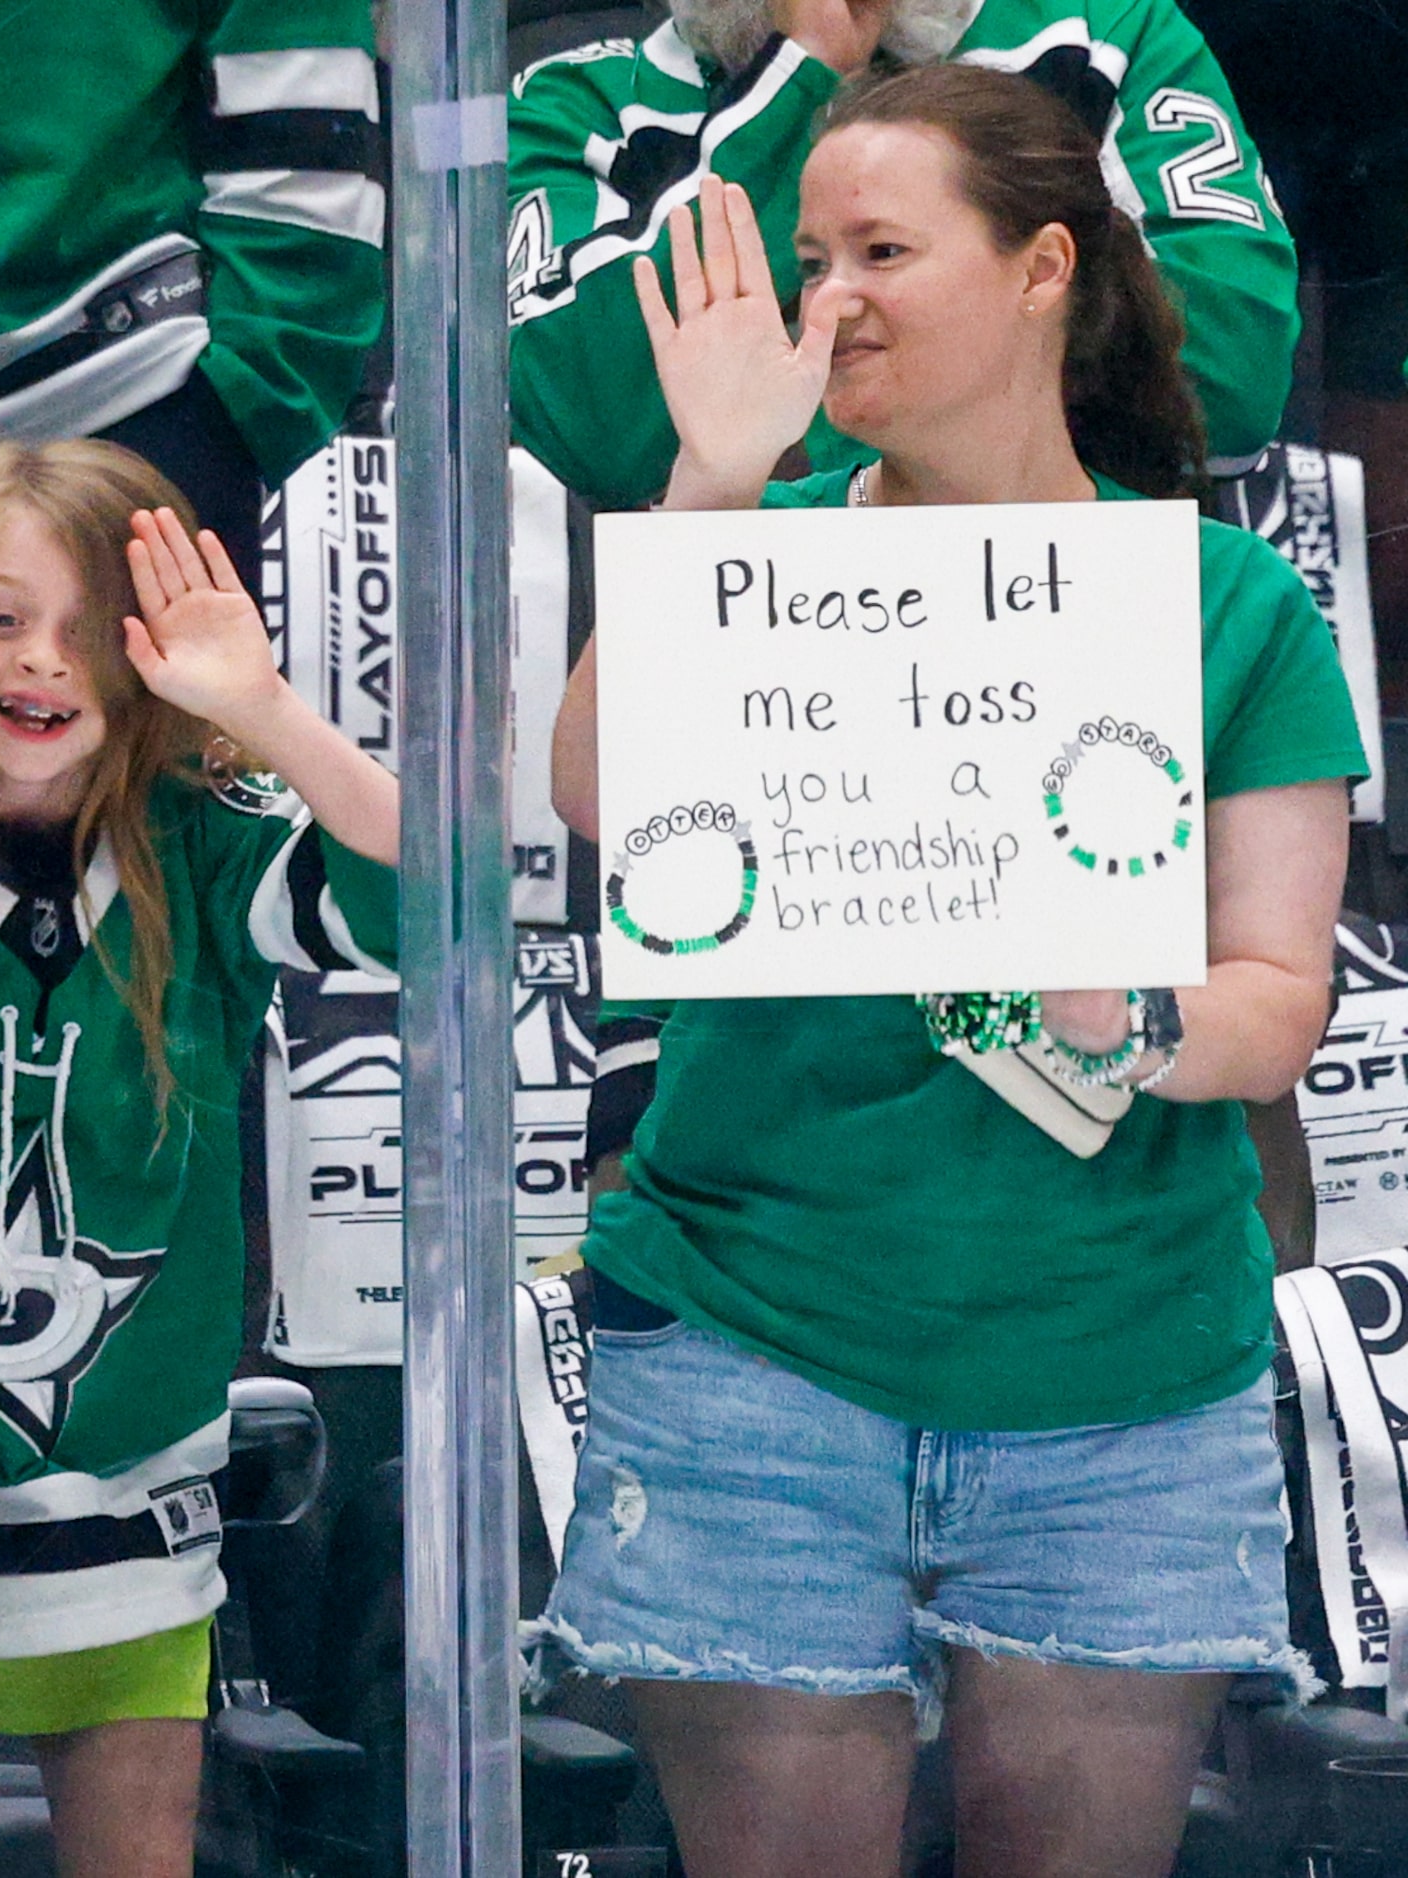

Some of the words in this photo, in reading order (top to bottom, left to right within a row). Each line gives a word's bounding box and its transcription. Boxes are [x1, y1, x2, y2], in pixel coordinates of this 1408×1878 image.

[1144, 87, 1283, 232] 2
[353, 444, 393, 752] LAYOFFS
[715, 559, 928, 634] Please
[984, 538, 1073, 622] let
[743, 686, 838, 732] me
[899, 662, 1038, 728] toss
[1080, 717, 1171, 765] STARS
[627, 803, 734, 853] OTTER
[761, 771, 873, 828] you
[951, 761, 991, 799] a
[773, 820, 1020, 882] friendship
[772, 877, 1000, 930] bracelet!
